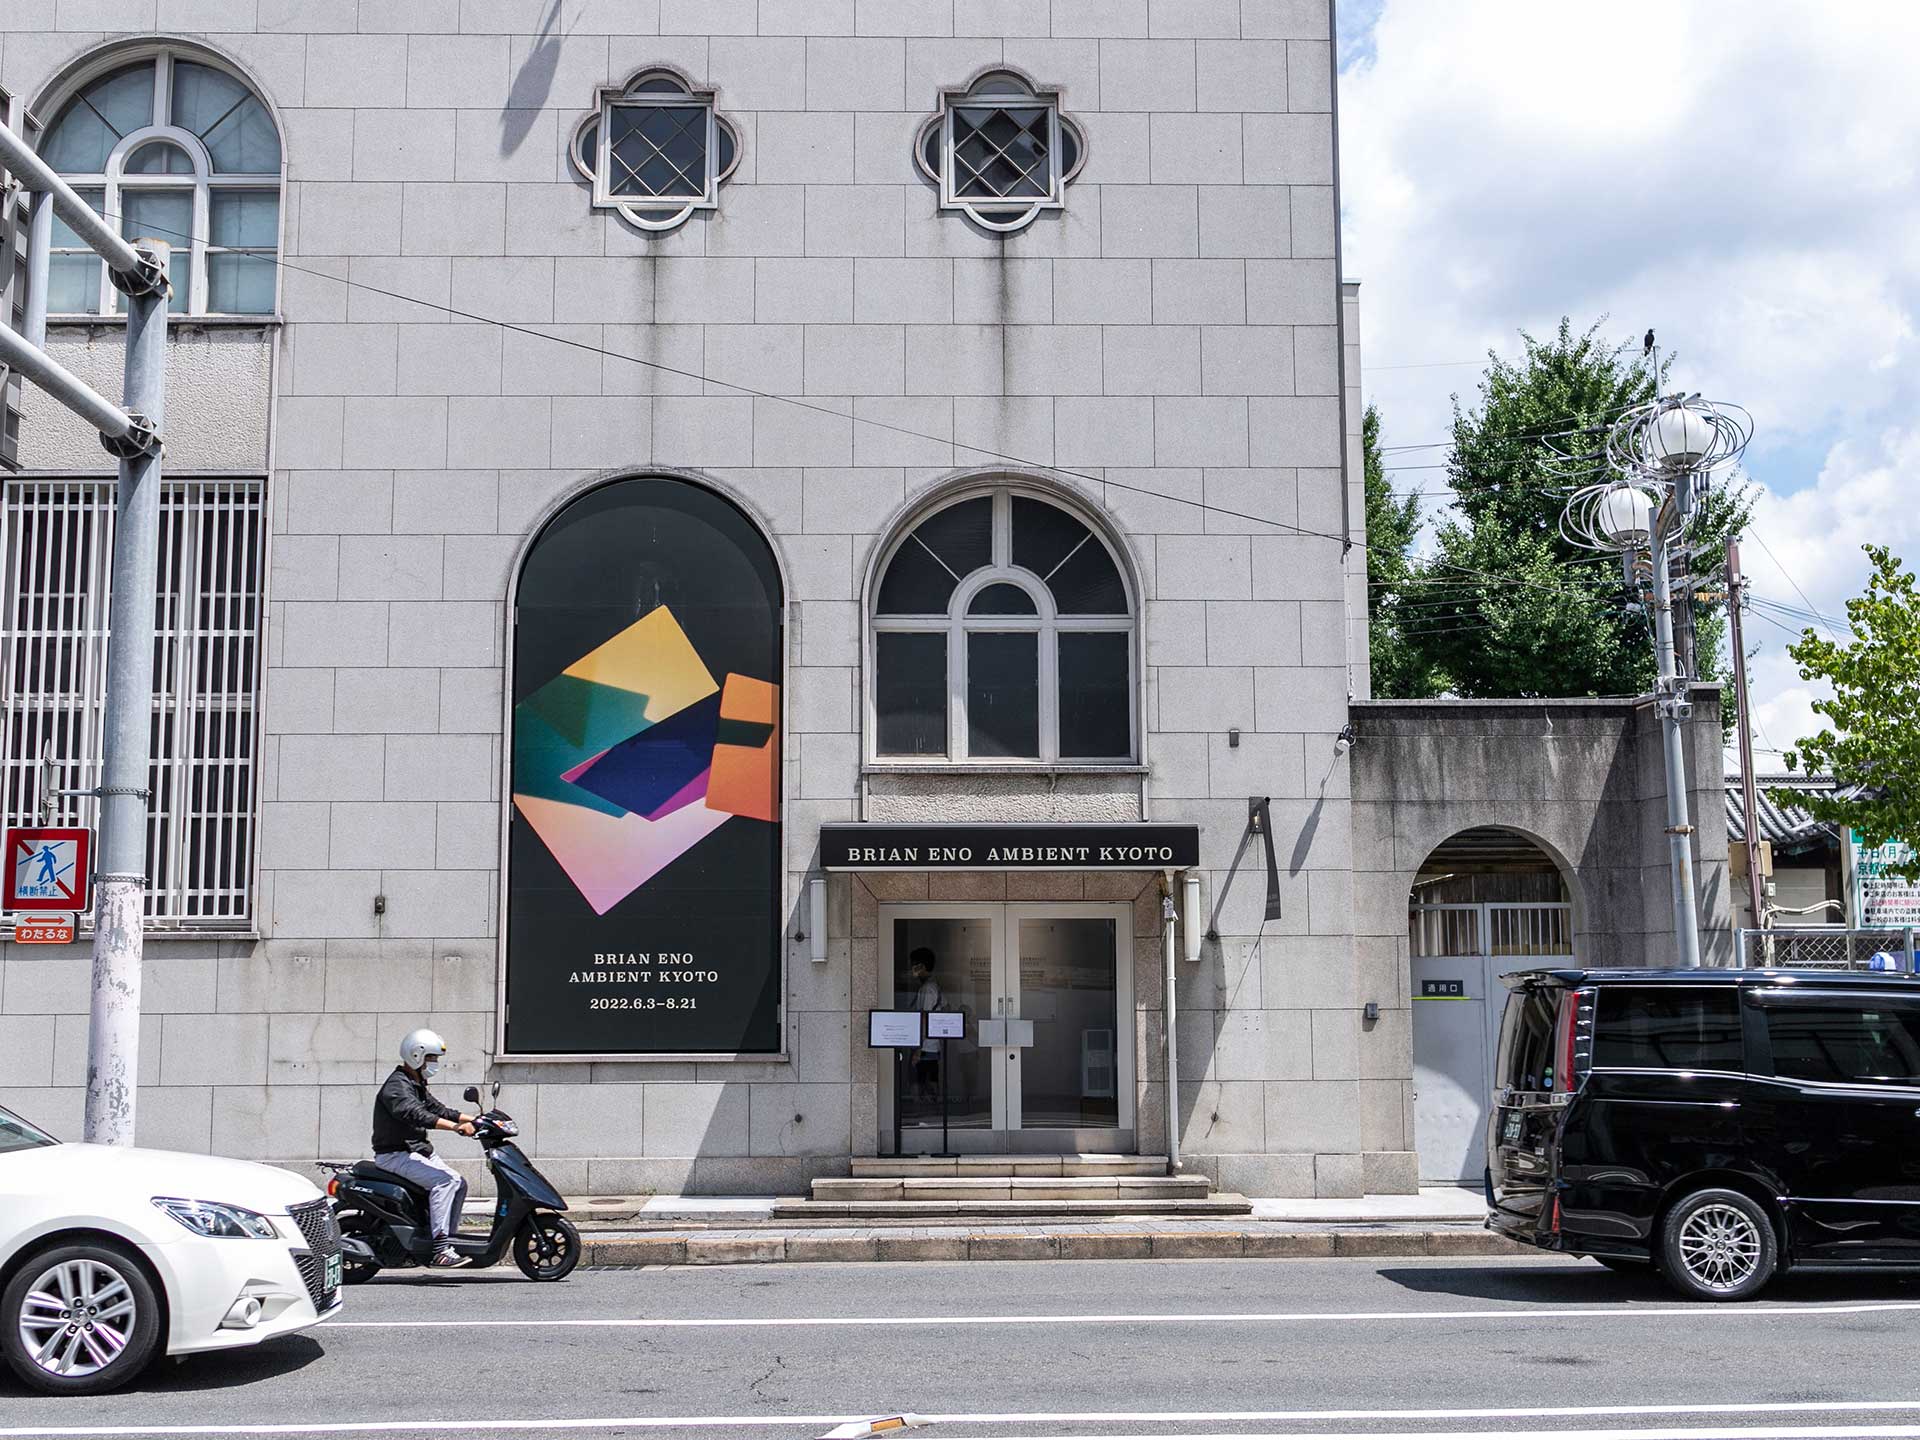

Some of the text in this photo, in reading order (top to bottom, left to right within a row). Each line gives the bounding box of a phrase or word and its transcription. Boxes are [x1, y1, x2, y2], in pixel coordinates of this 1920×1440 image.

[847, 846, 1173, 861] BRIAN ENO AMBIENT KYOTO
[18, 886, 58, 896] 横断禁止
[21, 929, 68, 939] わたるな
[594, 953, 694, 965] BRIAN ENO
[568, 971, 718, 983] AMBIENT KYOTO
